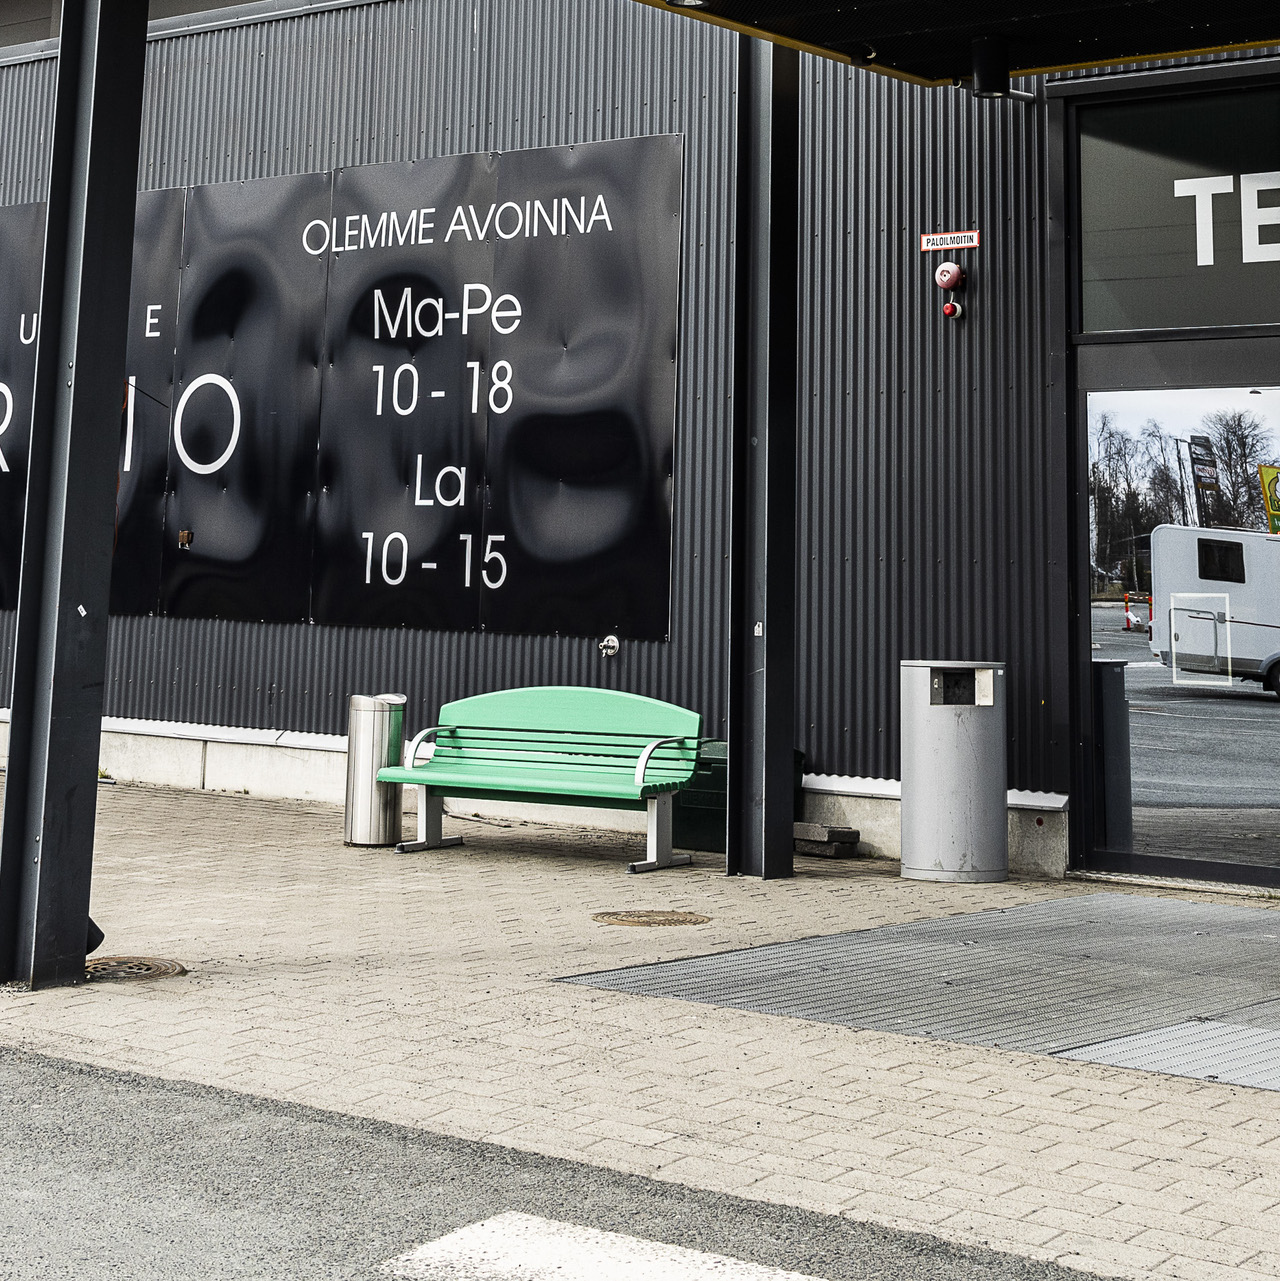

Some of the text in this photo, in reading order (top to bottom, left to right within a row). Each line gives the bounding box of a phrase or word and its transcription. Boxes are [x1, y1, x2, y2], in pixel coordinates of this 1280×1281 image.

[302, 194, 613, 259] OLEMME AVOINNA
[926, 235, 974, 247] PALOILMOITIN
[374, 283, 521, 338] Ma-Pe
[373, 360, 418, 415] 10
[467, 360, 512, 414] 18
[415, 454, 466, 506] La
[362, 532, 408, 585] 10
[460, 534, 506, 588] 15
